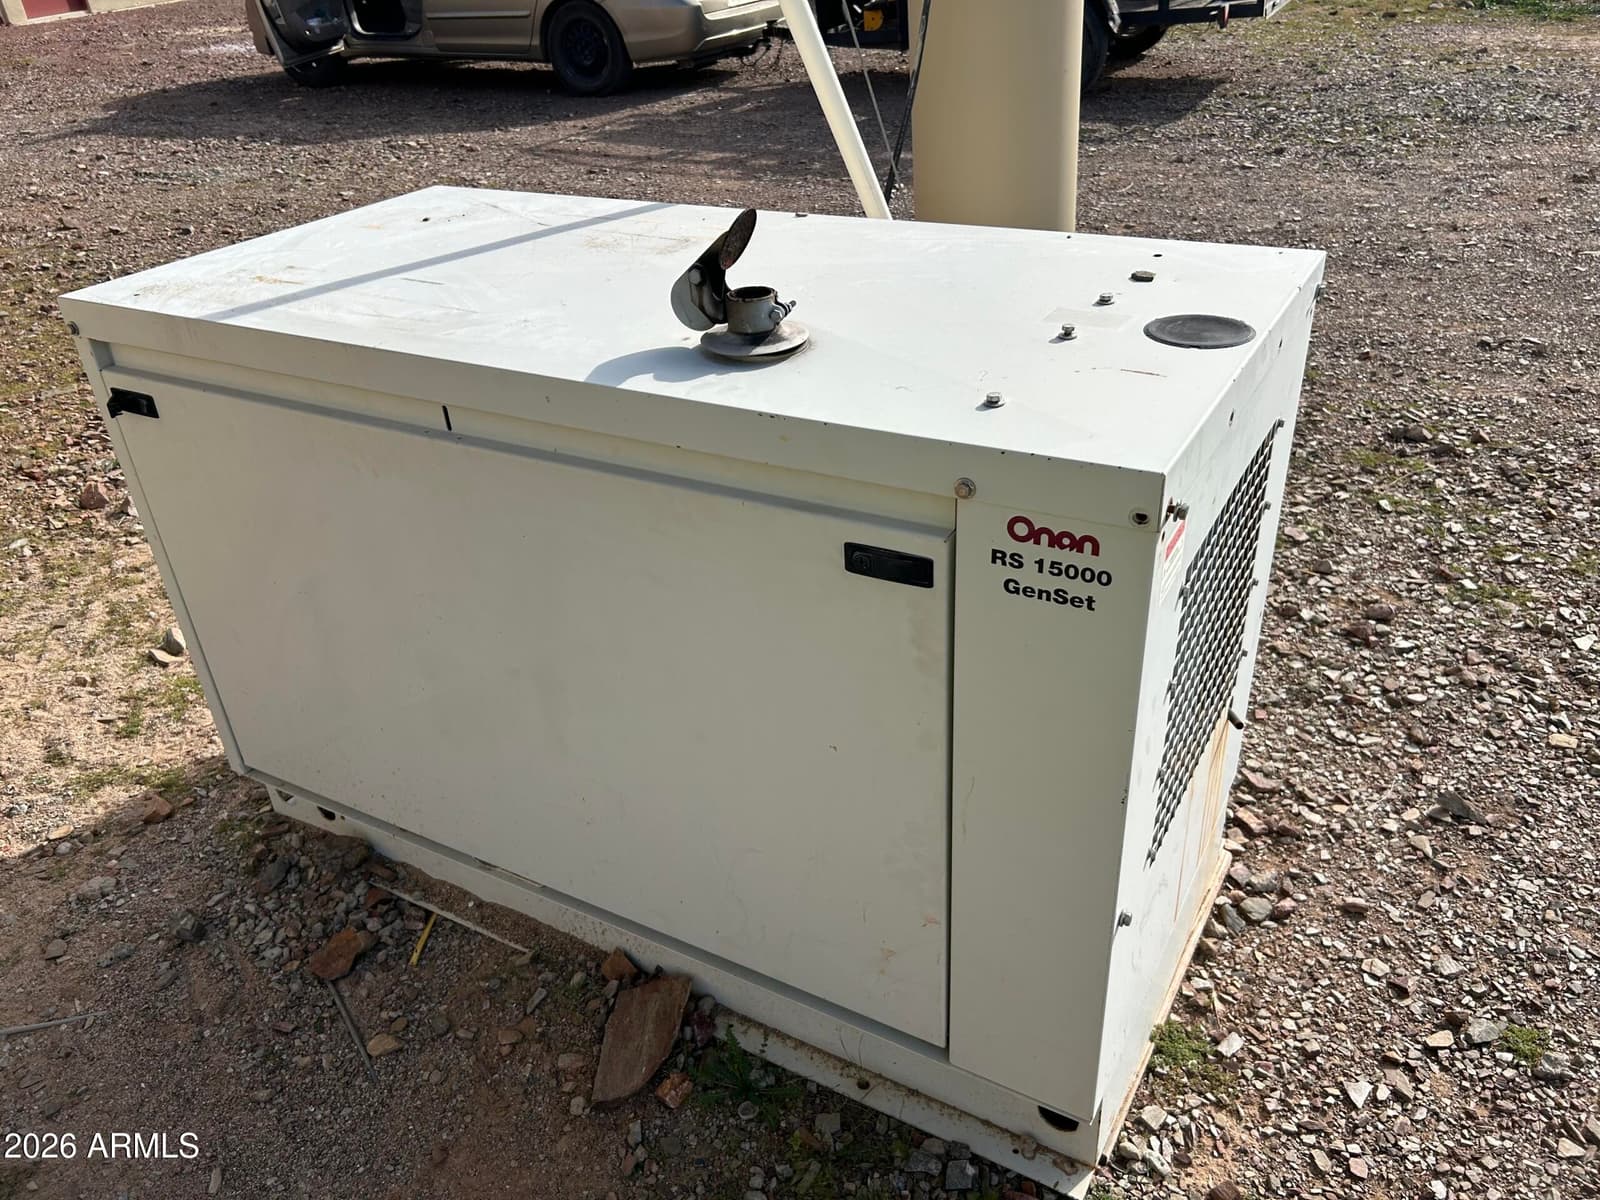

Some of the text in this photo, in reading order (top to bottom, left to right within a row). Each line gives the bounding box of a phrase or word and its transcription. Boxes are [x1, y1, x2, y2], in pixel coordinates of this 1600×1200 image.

[1007, 515, 1100, 557] Onan
[991, 548, 1113, 587] RS 15000
[1003, 578, 1096, 611] GenSet
